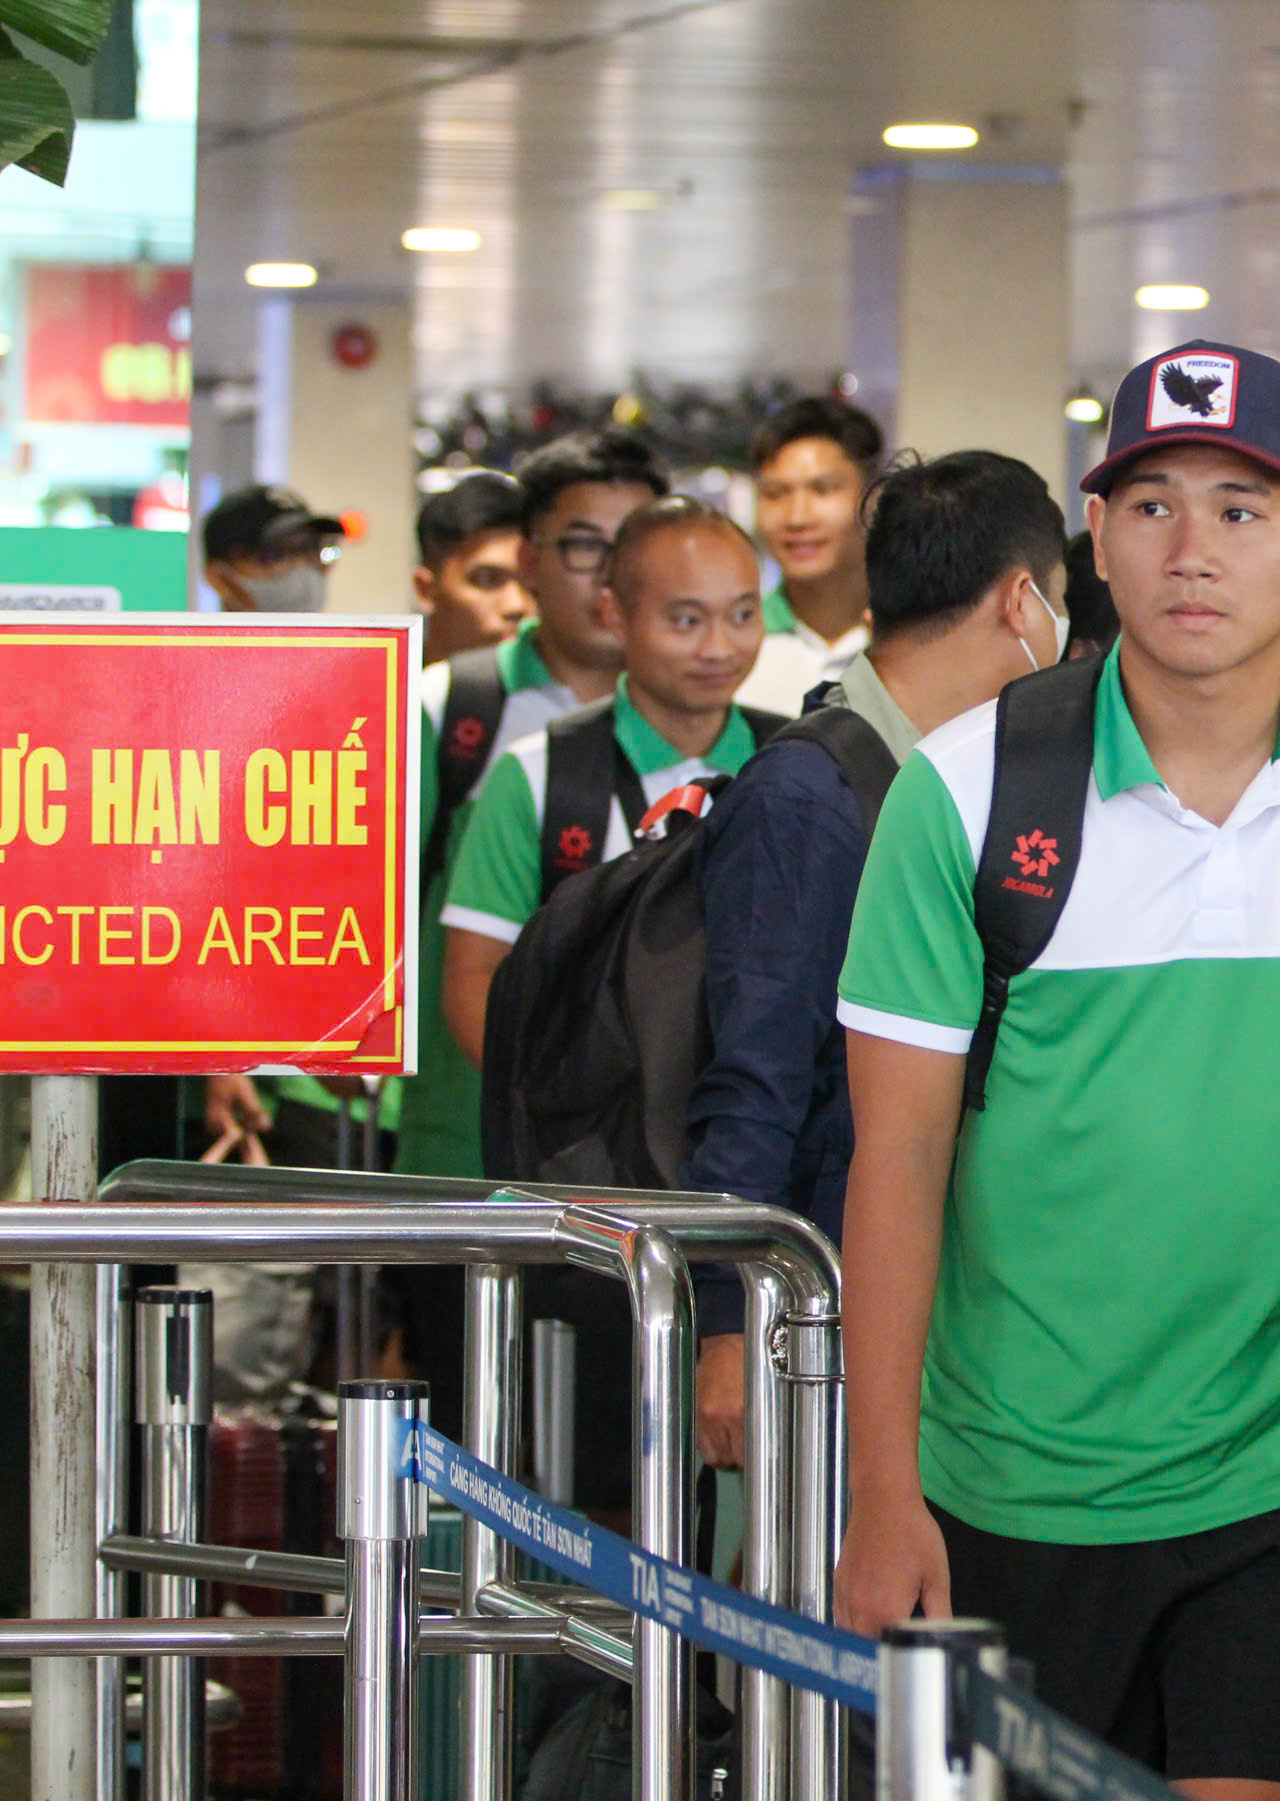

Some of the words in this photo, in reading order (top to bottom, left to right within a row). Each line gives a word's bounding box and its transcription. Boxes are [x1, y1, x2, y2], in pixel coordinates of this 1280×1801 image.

[1186, 359, 1231, 369] FREEDOM
[91, 748, 221, 864] HẠN
[245, 716, 369, 847] CHẾ
[197, 906, 371, 966] AREA
[450, 1453, 469, 1495] CẢNG
[469, 1465, 488, 1507] HÀNG
[488, 1481, 511, 1524] KHÔNG
[512, 1495, 532, 1537] QUỐC
[532, 1504, 543, 1543] TẾ
[629, 1552, 662, 1614] TIA
